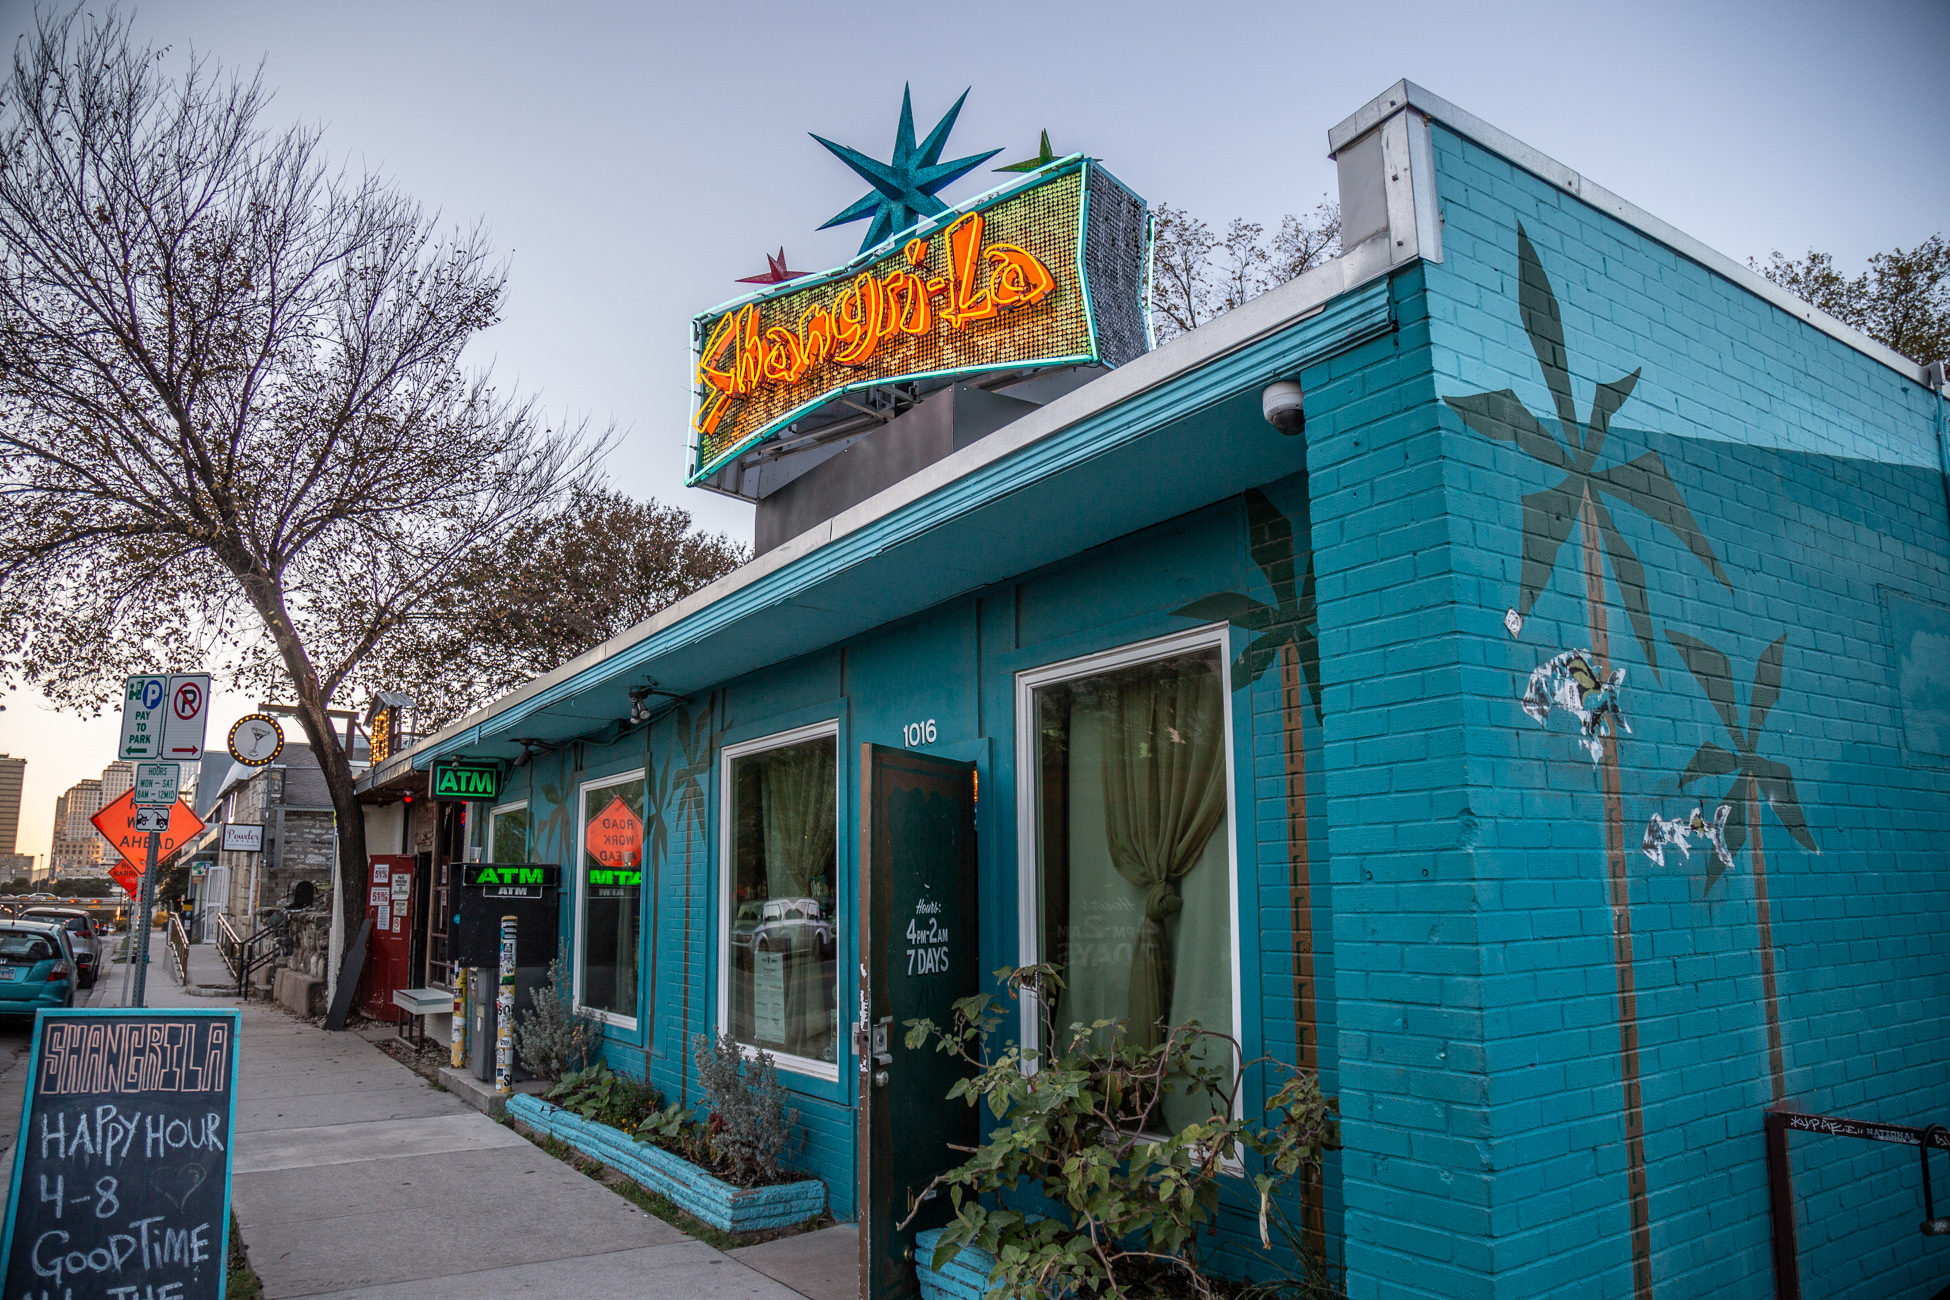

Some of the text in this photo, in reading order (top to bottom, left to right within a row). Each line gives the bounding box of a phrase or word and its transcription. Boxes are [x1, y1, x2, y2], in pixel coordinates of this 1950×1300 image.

[693, 211, 1056, 436] Shangri-La
[135, 711, 151, 720] PAY
[136, 723, 147, 732] TO
[903, 719, 937, 749] 1016
[129, 735, 151, 744] PARK
[148, 767, 167, 776] HOURS
[140, 779, 153, 788] MON
[162, 779, 174, 788] SAT
[440, 771, 492, 793] ATM
[137, 791, 149, 799] 8AM
[158, 791, 175, 799] 12MID
[226, 829, 260, 841] Powder
[119, 836, 174, 850] AHED
[476, 868, 544, 884] ATM
[498, 887, 527, 896] ATM
[916, 898, 942, 915] Hours:
[906, 946, 949, 976] 7 DAYS
[40, 1023, 228, 1094] SHANGRILA
[40, 1104, 224, 1166] HAPPY HOUR
[1866, 1127, 1918, 1140] NATIONAL
